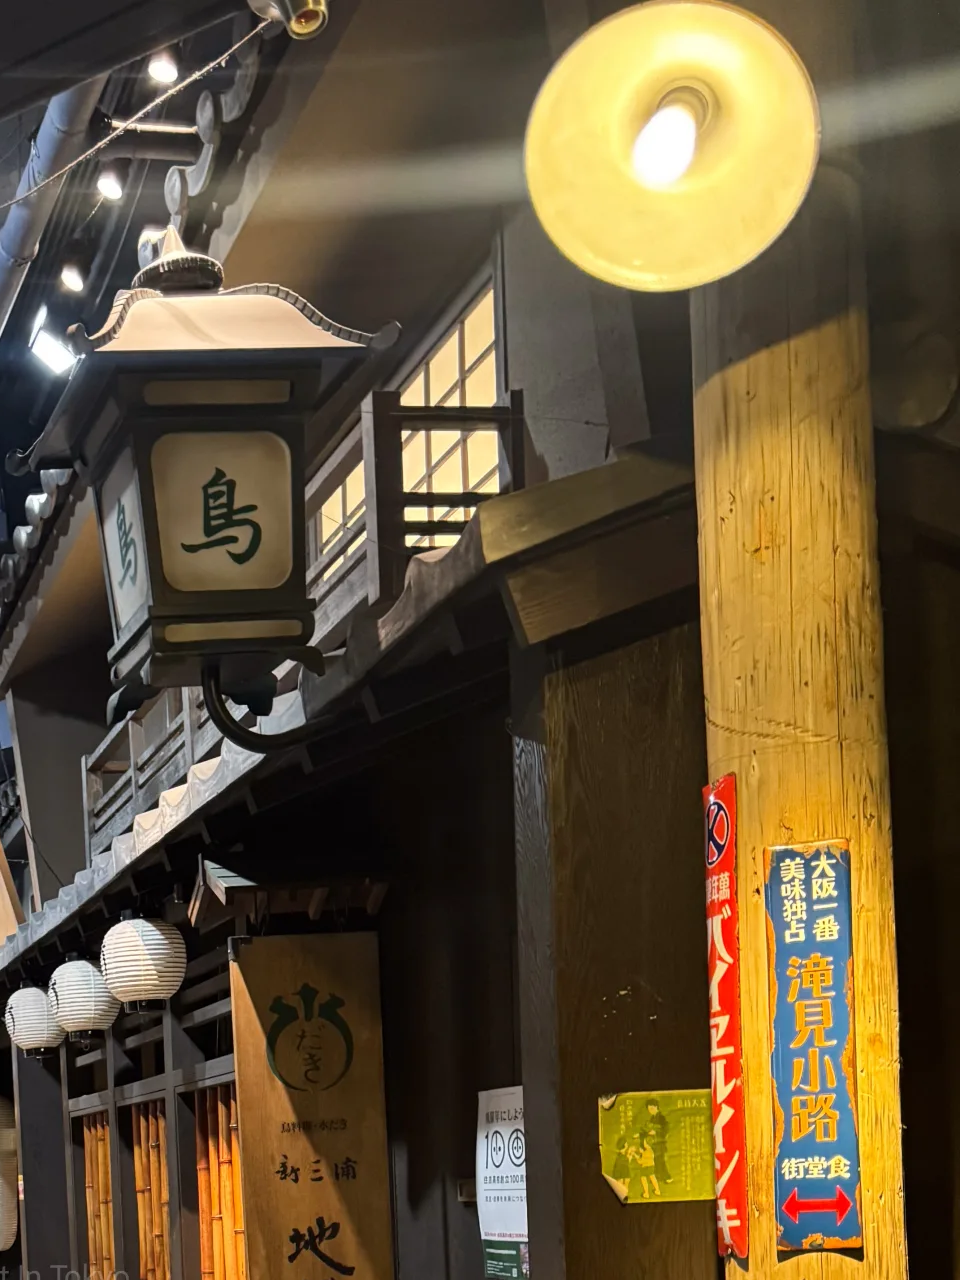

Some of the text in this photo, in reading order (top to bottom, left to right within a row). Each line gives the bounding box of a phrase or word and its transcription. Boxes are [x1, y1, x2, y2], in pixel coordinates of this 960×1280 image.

[117, 497, 138, 590] 鳥
[181, 467, 262, 565] 鳥
[779, 857, 807, 944] 美味独占
[810, 855, 840, 942] 大阪一番
[786, 952, 840, 1144] 滝見小路
[275, 1154, 358, 1184] 新三浦
